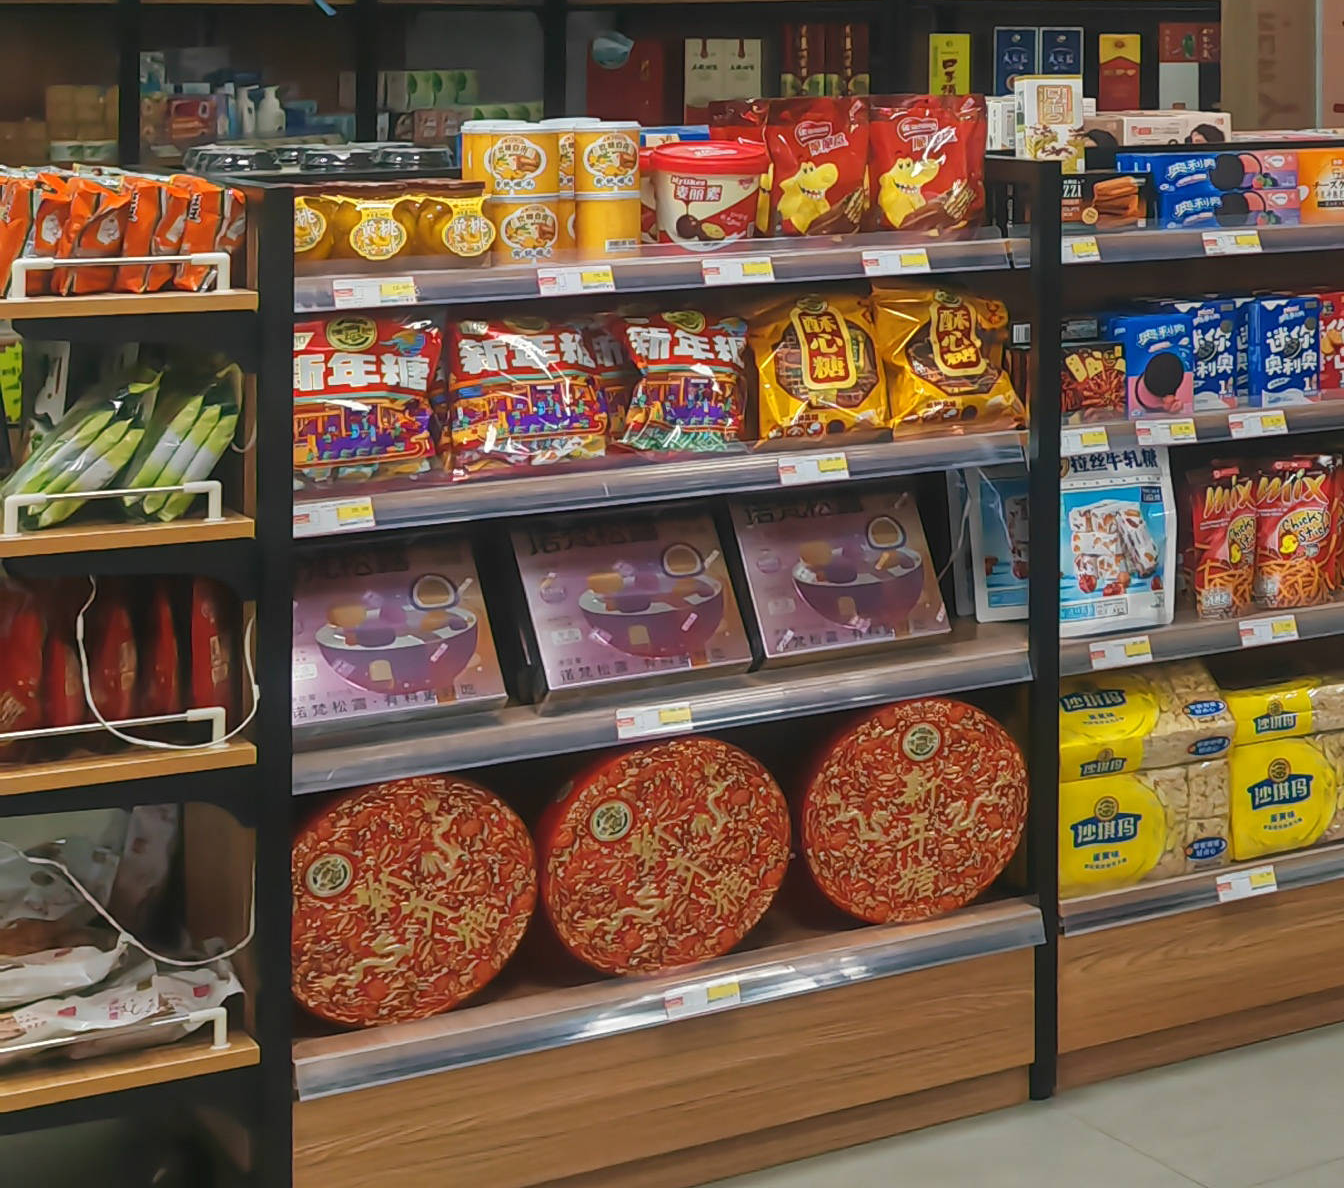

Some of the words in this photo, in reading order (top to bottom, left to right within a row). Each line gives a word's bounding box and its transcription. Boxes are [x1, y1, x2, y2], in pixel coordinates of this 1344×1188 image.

[675, 186, 723, 202] 麦丽素
[802, 313, 846, 380] 酥心糖
[938, 307, 978, 366] 酥心糖
[1136, 323, 1186, 346] 奥利奥
[1266, 327, 1315, 354] 迷你
[293, 353, 429, 392] 新年糖
[1265, 352, 1318, 377] 奥利奥
[1251, 778, 1311, 810] 沙琪玛
[1074, 817, 1139, 845] 沙琪玛
